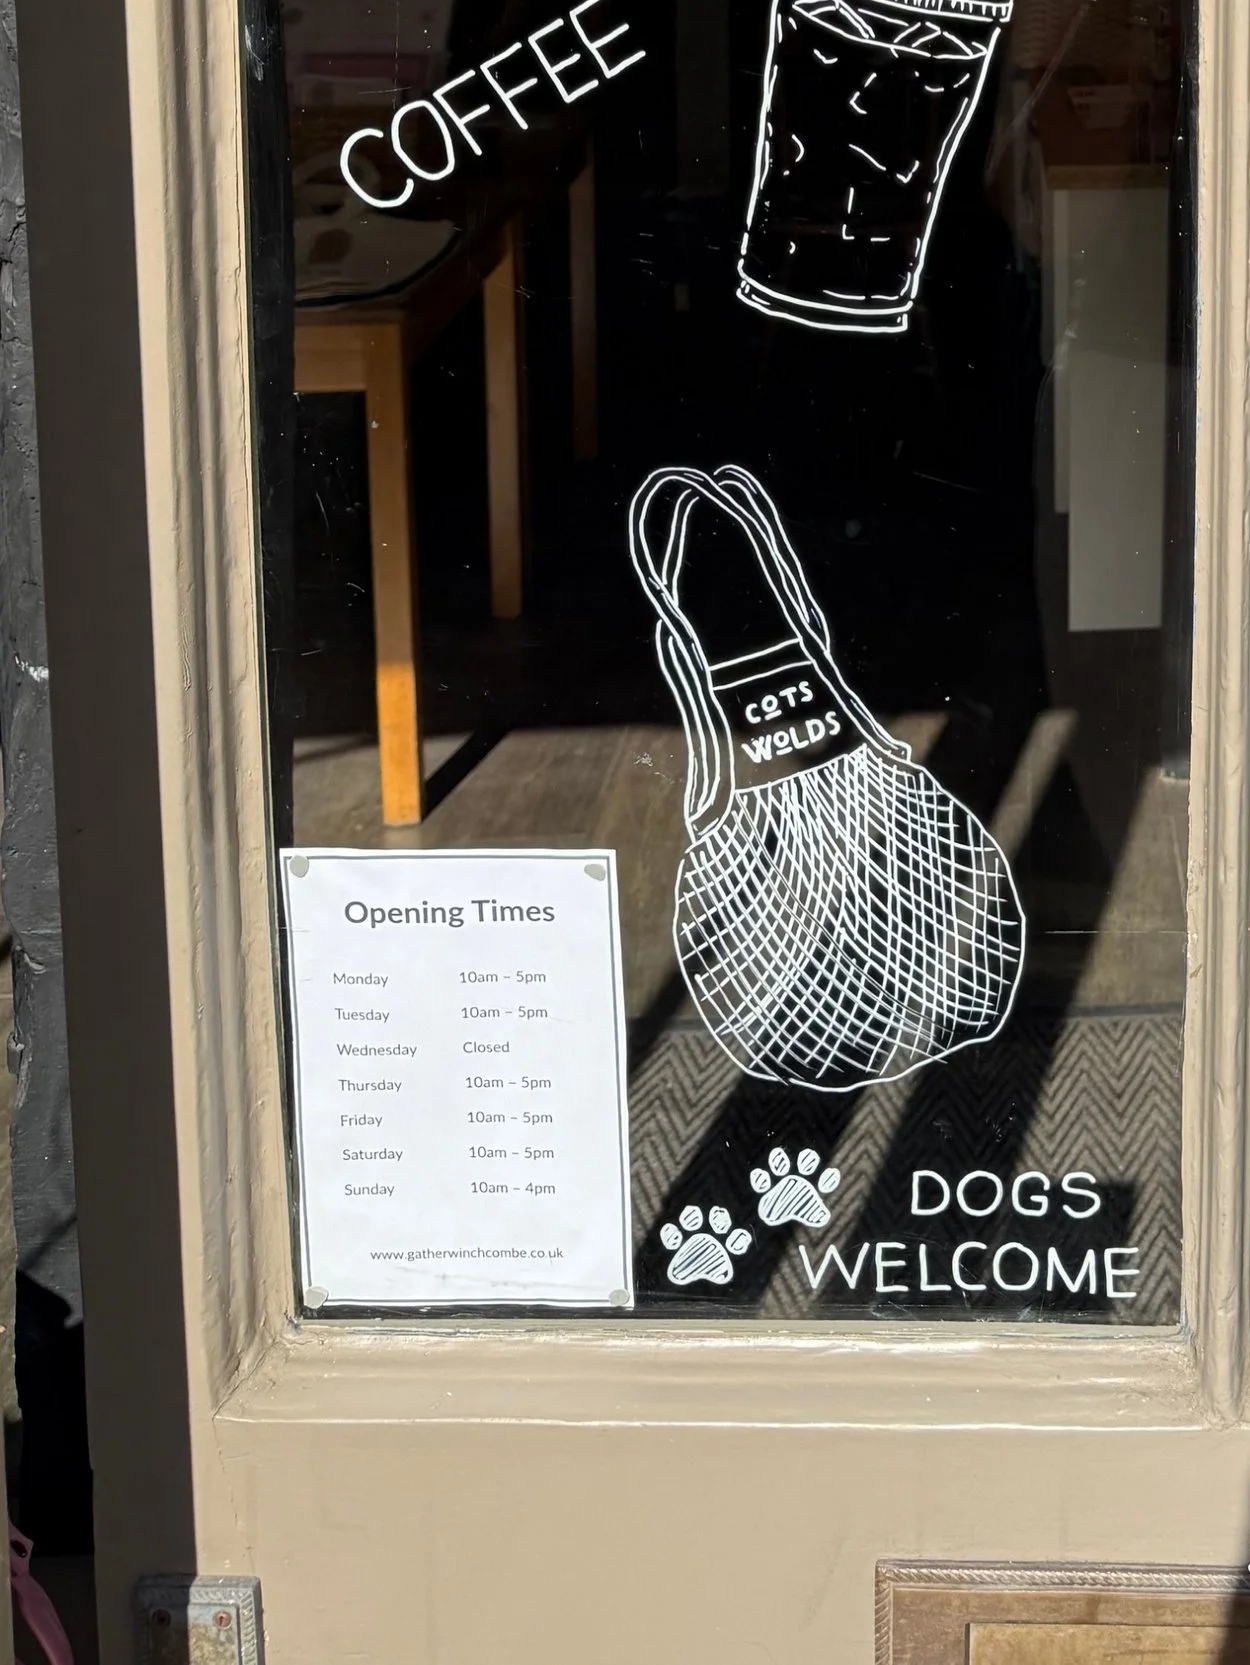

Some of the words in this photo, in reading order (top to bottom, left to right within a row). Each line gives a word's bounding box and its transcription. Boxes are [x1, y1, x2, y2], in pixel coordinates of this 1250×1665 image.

[745, 680, 814, 724] COTS
[742, 711, 841, 764] WOLDS
[344, 900, 465, 929] Opening
[471, 899, 555, 922] Times
[333, 972, 389, 988] Monday
[459, 971, 499, 984] 10am
[516, 970, 546, 985] 5pm
[334, 1007, 390, 1023] Tuesday
[461, 1006, 500, 1019] 10am
[518, 1005, 548, 1020] 5pm
[336, 1043, 418, 1058] Wednesday
[462, 1041, 510, 1054] Closed
[338, 1079, 402, 1093] Thursday
[465, 1076, 504, 1089] 10am
[521, 1076, 552, 1090] 5pm
[340, 1113, 383, 1127] Friday
[467, 1111, 506, 1123] 10am
[523, 1111, 553, 1126] 5pm
[342, 1147, 403, 1162] Saturday
[469, 1146, 507, 1159] 10am
[524, 1146, 555, 1161] 5pm
[344, 1183, 395, 1197] Sunday
[471, 1181, 509, 1194] 10am
[525, 1182, 556, 1196] 4pm
[912, 1171, 1100, 1218] DOGS
[370, 1247, 564, 1262] www.gatherwinchcombe.co.uk
[799, 1242, 1139, 1297] WELCOME
